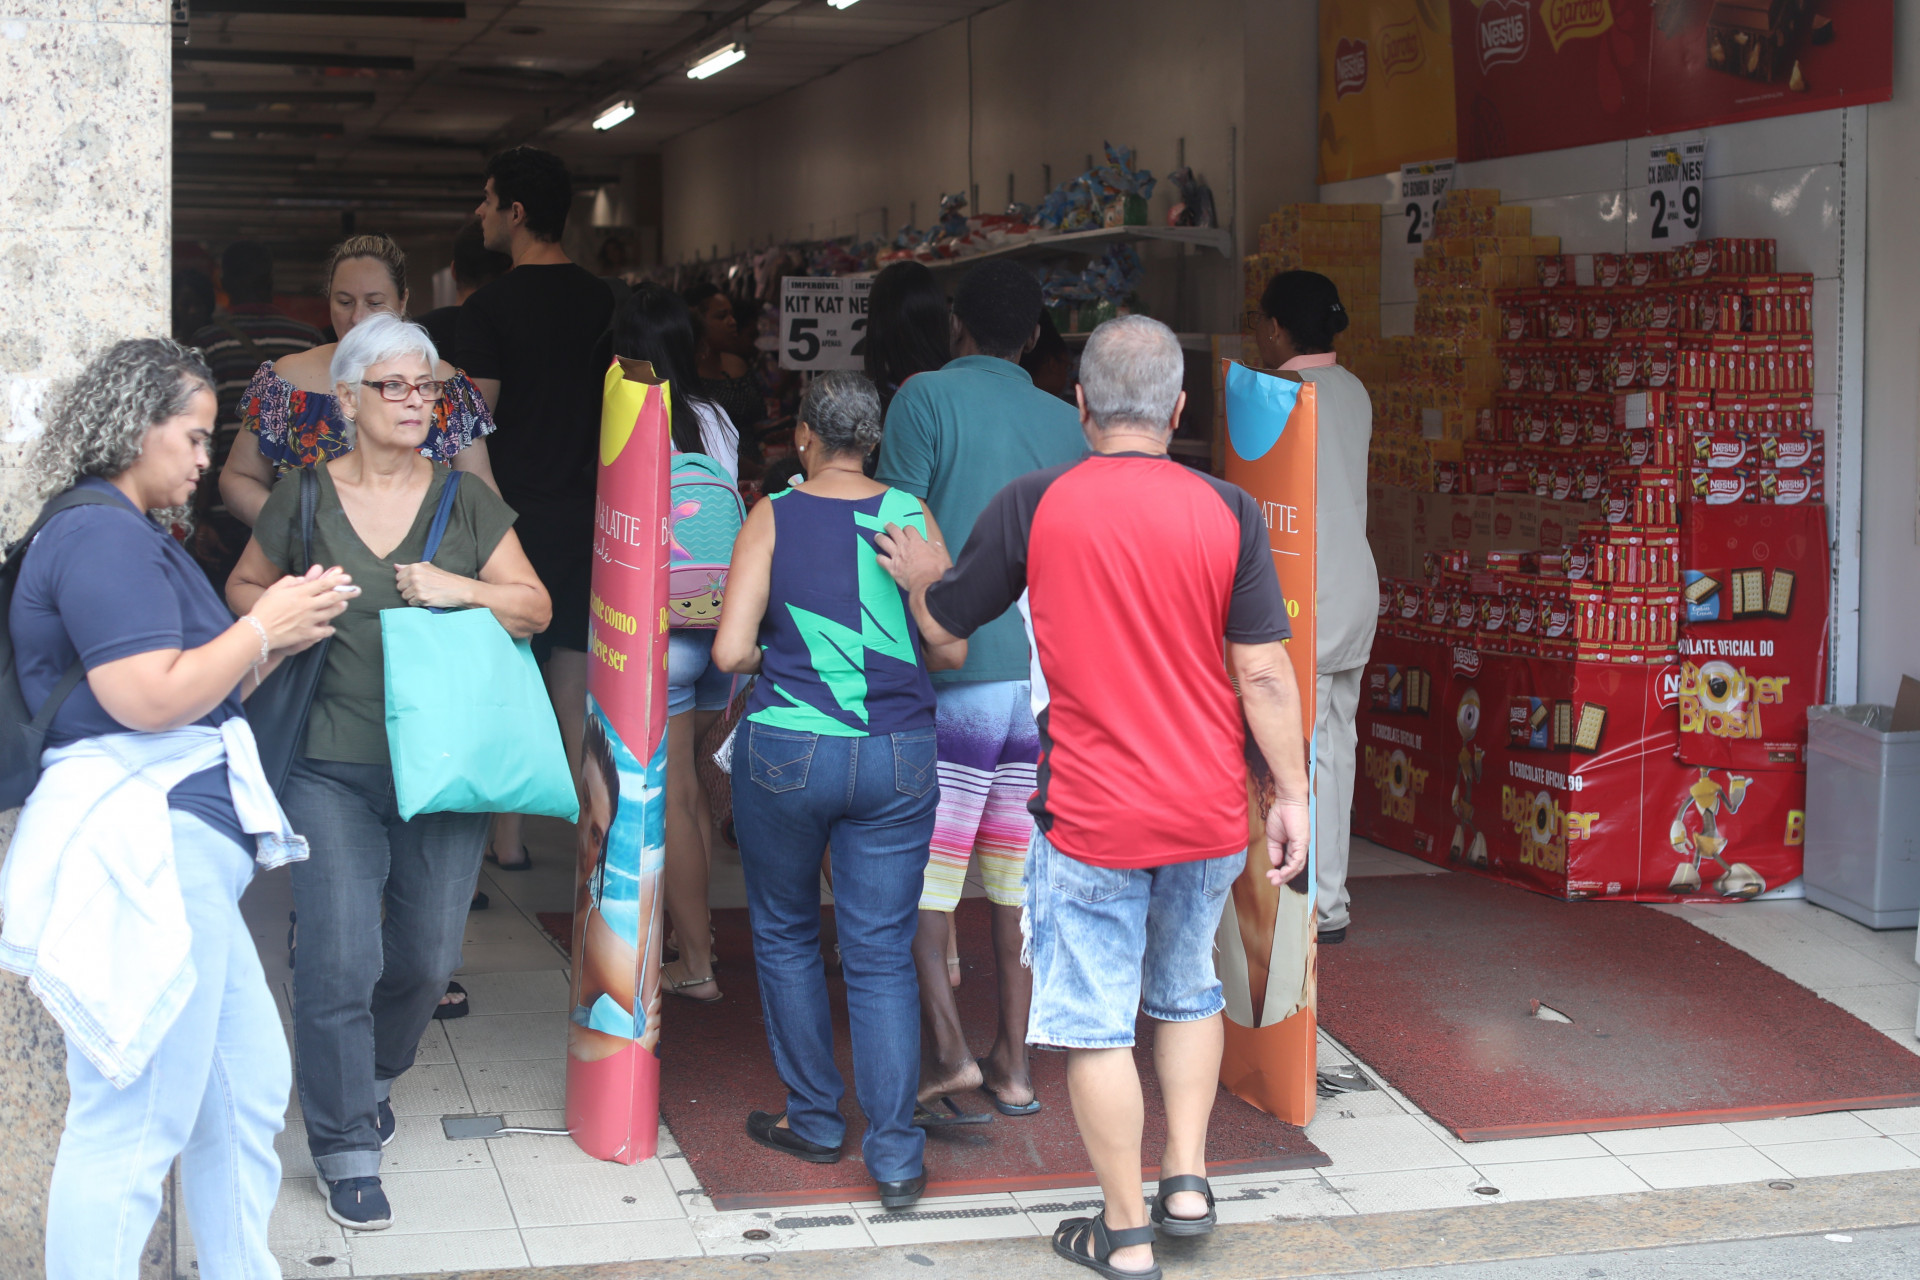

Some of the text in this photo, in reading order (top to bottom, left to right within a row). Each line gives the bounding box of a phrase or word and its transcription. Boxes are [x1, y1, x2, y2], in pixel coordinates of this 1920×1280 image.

[1481, 14, 1524, 48] Nestlé
[1336, 51, 1365, 81] Nestlé
[1682, 162, 1702, 181] NES
[1405, 202, 1422, 244] 2
[1650, 190, 1668, 239] 2
[1682, 186, 1701, 229] 9
[791, 280, 839, 290] IMPERDÍVEL
[785, 296, 809, 313] KIT
[815, 296, 843, 313] KAT
[788, 318, 820, 362] 5
[605, 505, 641, 547] LATTE
[605, 605, 638, 636] como
[608, 648, 628, 673] ser
[1718, 639, 1757, 657] OFICIAL
[1760, 640, 1774, 657] DO
[1664, 673, 1681, 692] N
[1514, 761, 1544, 785] CHOCOLATE
[1545, 769, 1567, 790] OFICIAL
[1568, 775, 1583, 792] DO
